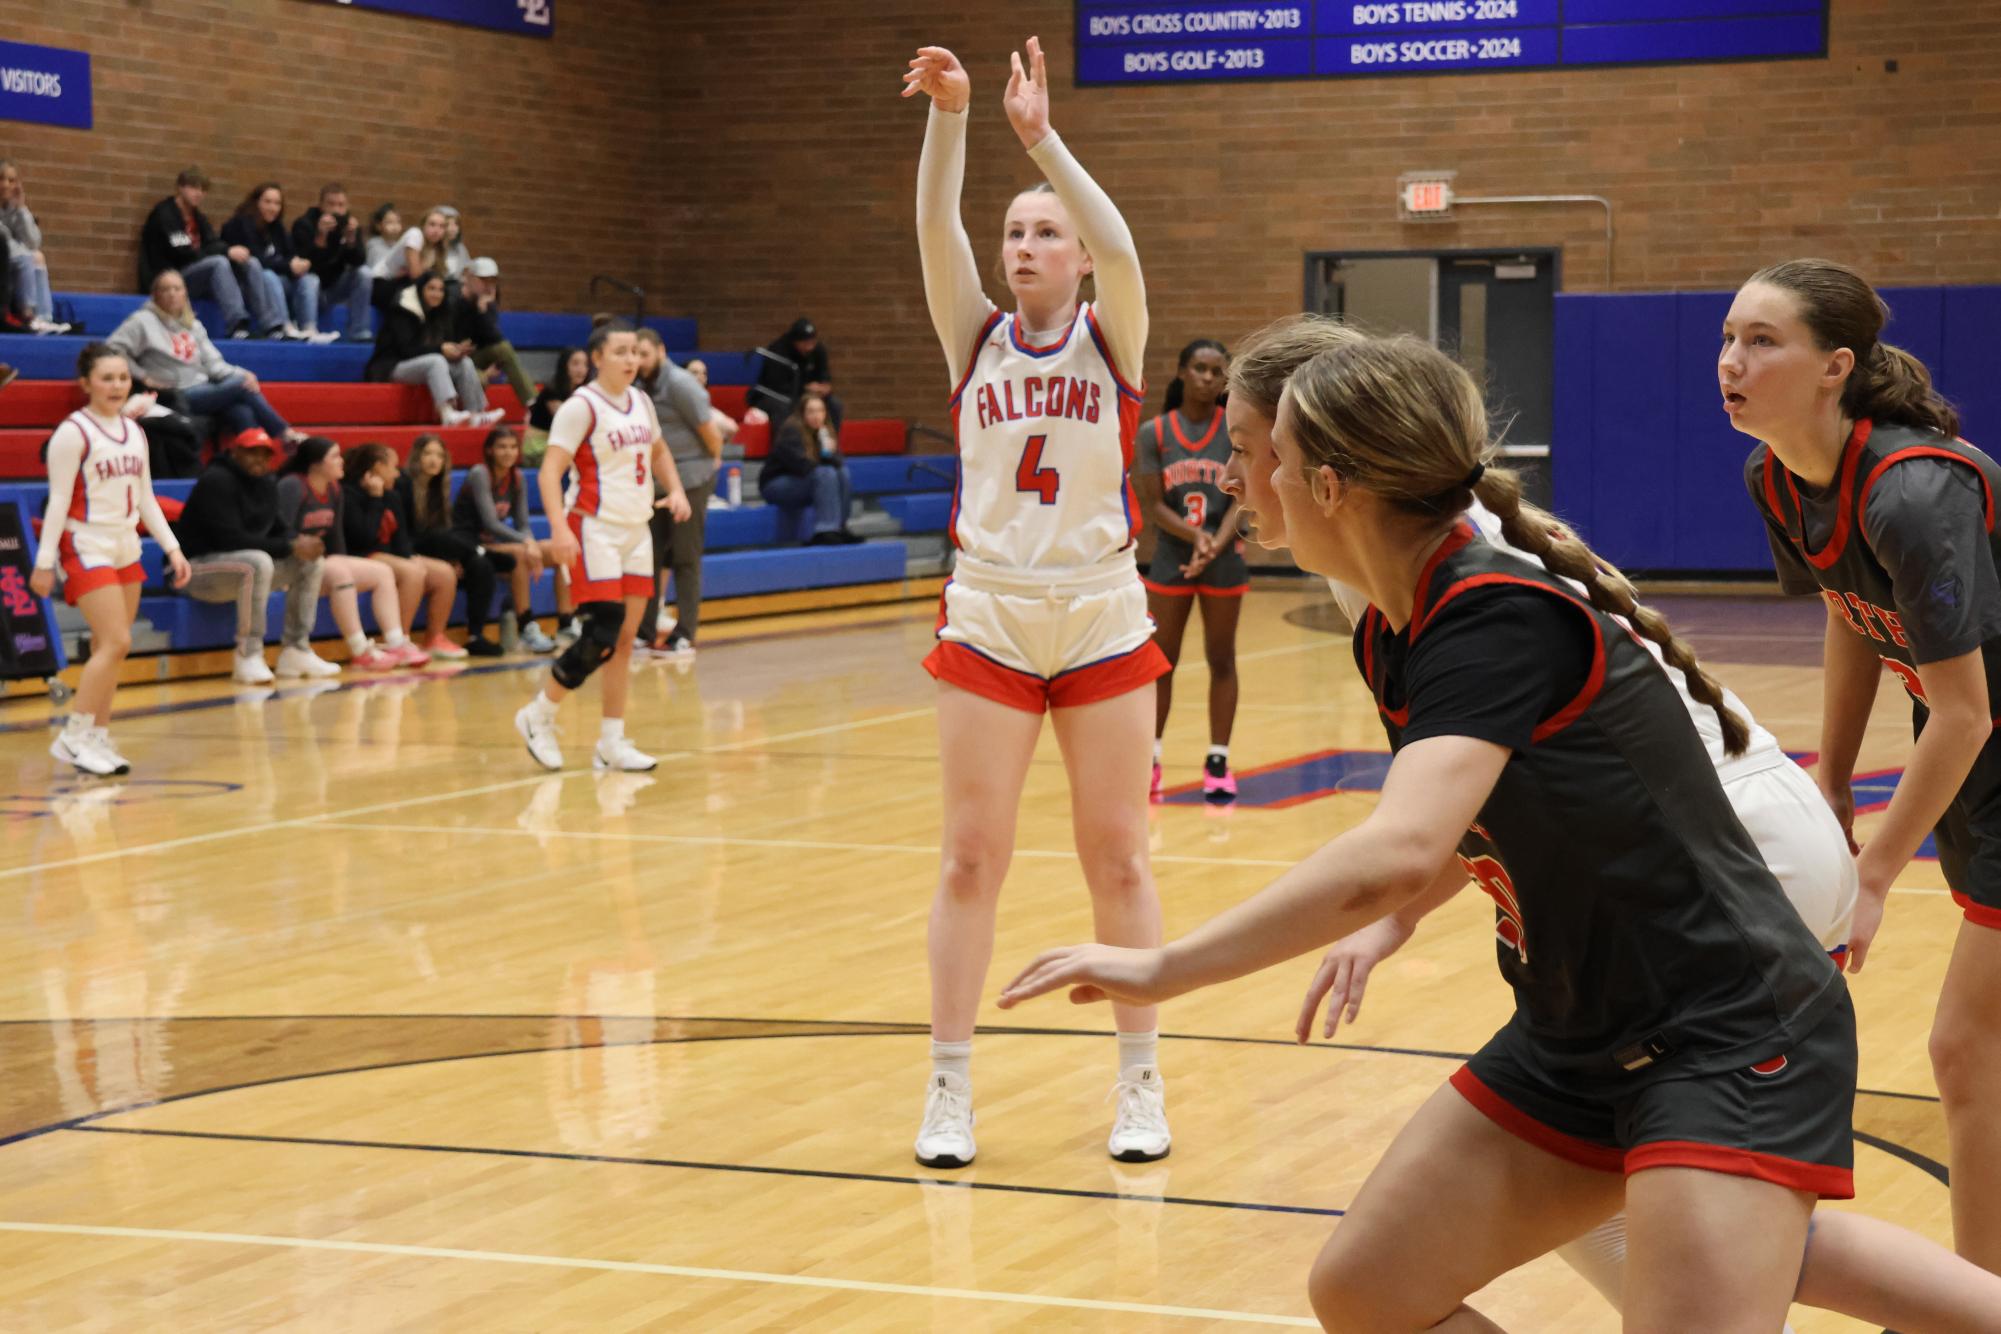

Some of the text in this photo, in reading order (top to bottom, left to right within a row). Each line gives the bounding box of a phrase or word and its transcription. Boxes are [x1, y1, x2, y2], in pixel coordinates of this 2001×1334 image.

[1090, 16, 1130, 36] BOYS
[1132, 13, 1182, 34] CROSS
[1353, 4, 1399, 25] BOYS
[1124, 52, 1169, 73] BOYS
[1351, 43, 1397, 64] BOYS
[0, 67, 62, 97] VISITORS
[1413, 183, 1440, 209] EXIT
[977, 376, 1100, 429] FALCONS
[636, 452, 646, 486] 5
[1016, 434, 1060, 505] 4
[126, 484, 132, 518] 1
[1183, 493, 1207, 528] 3
